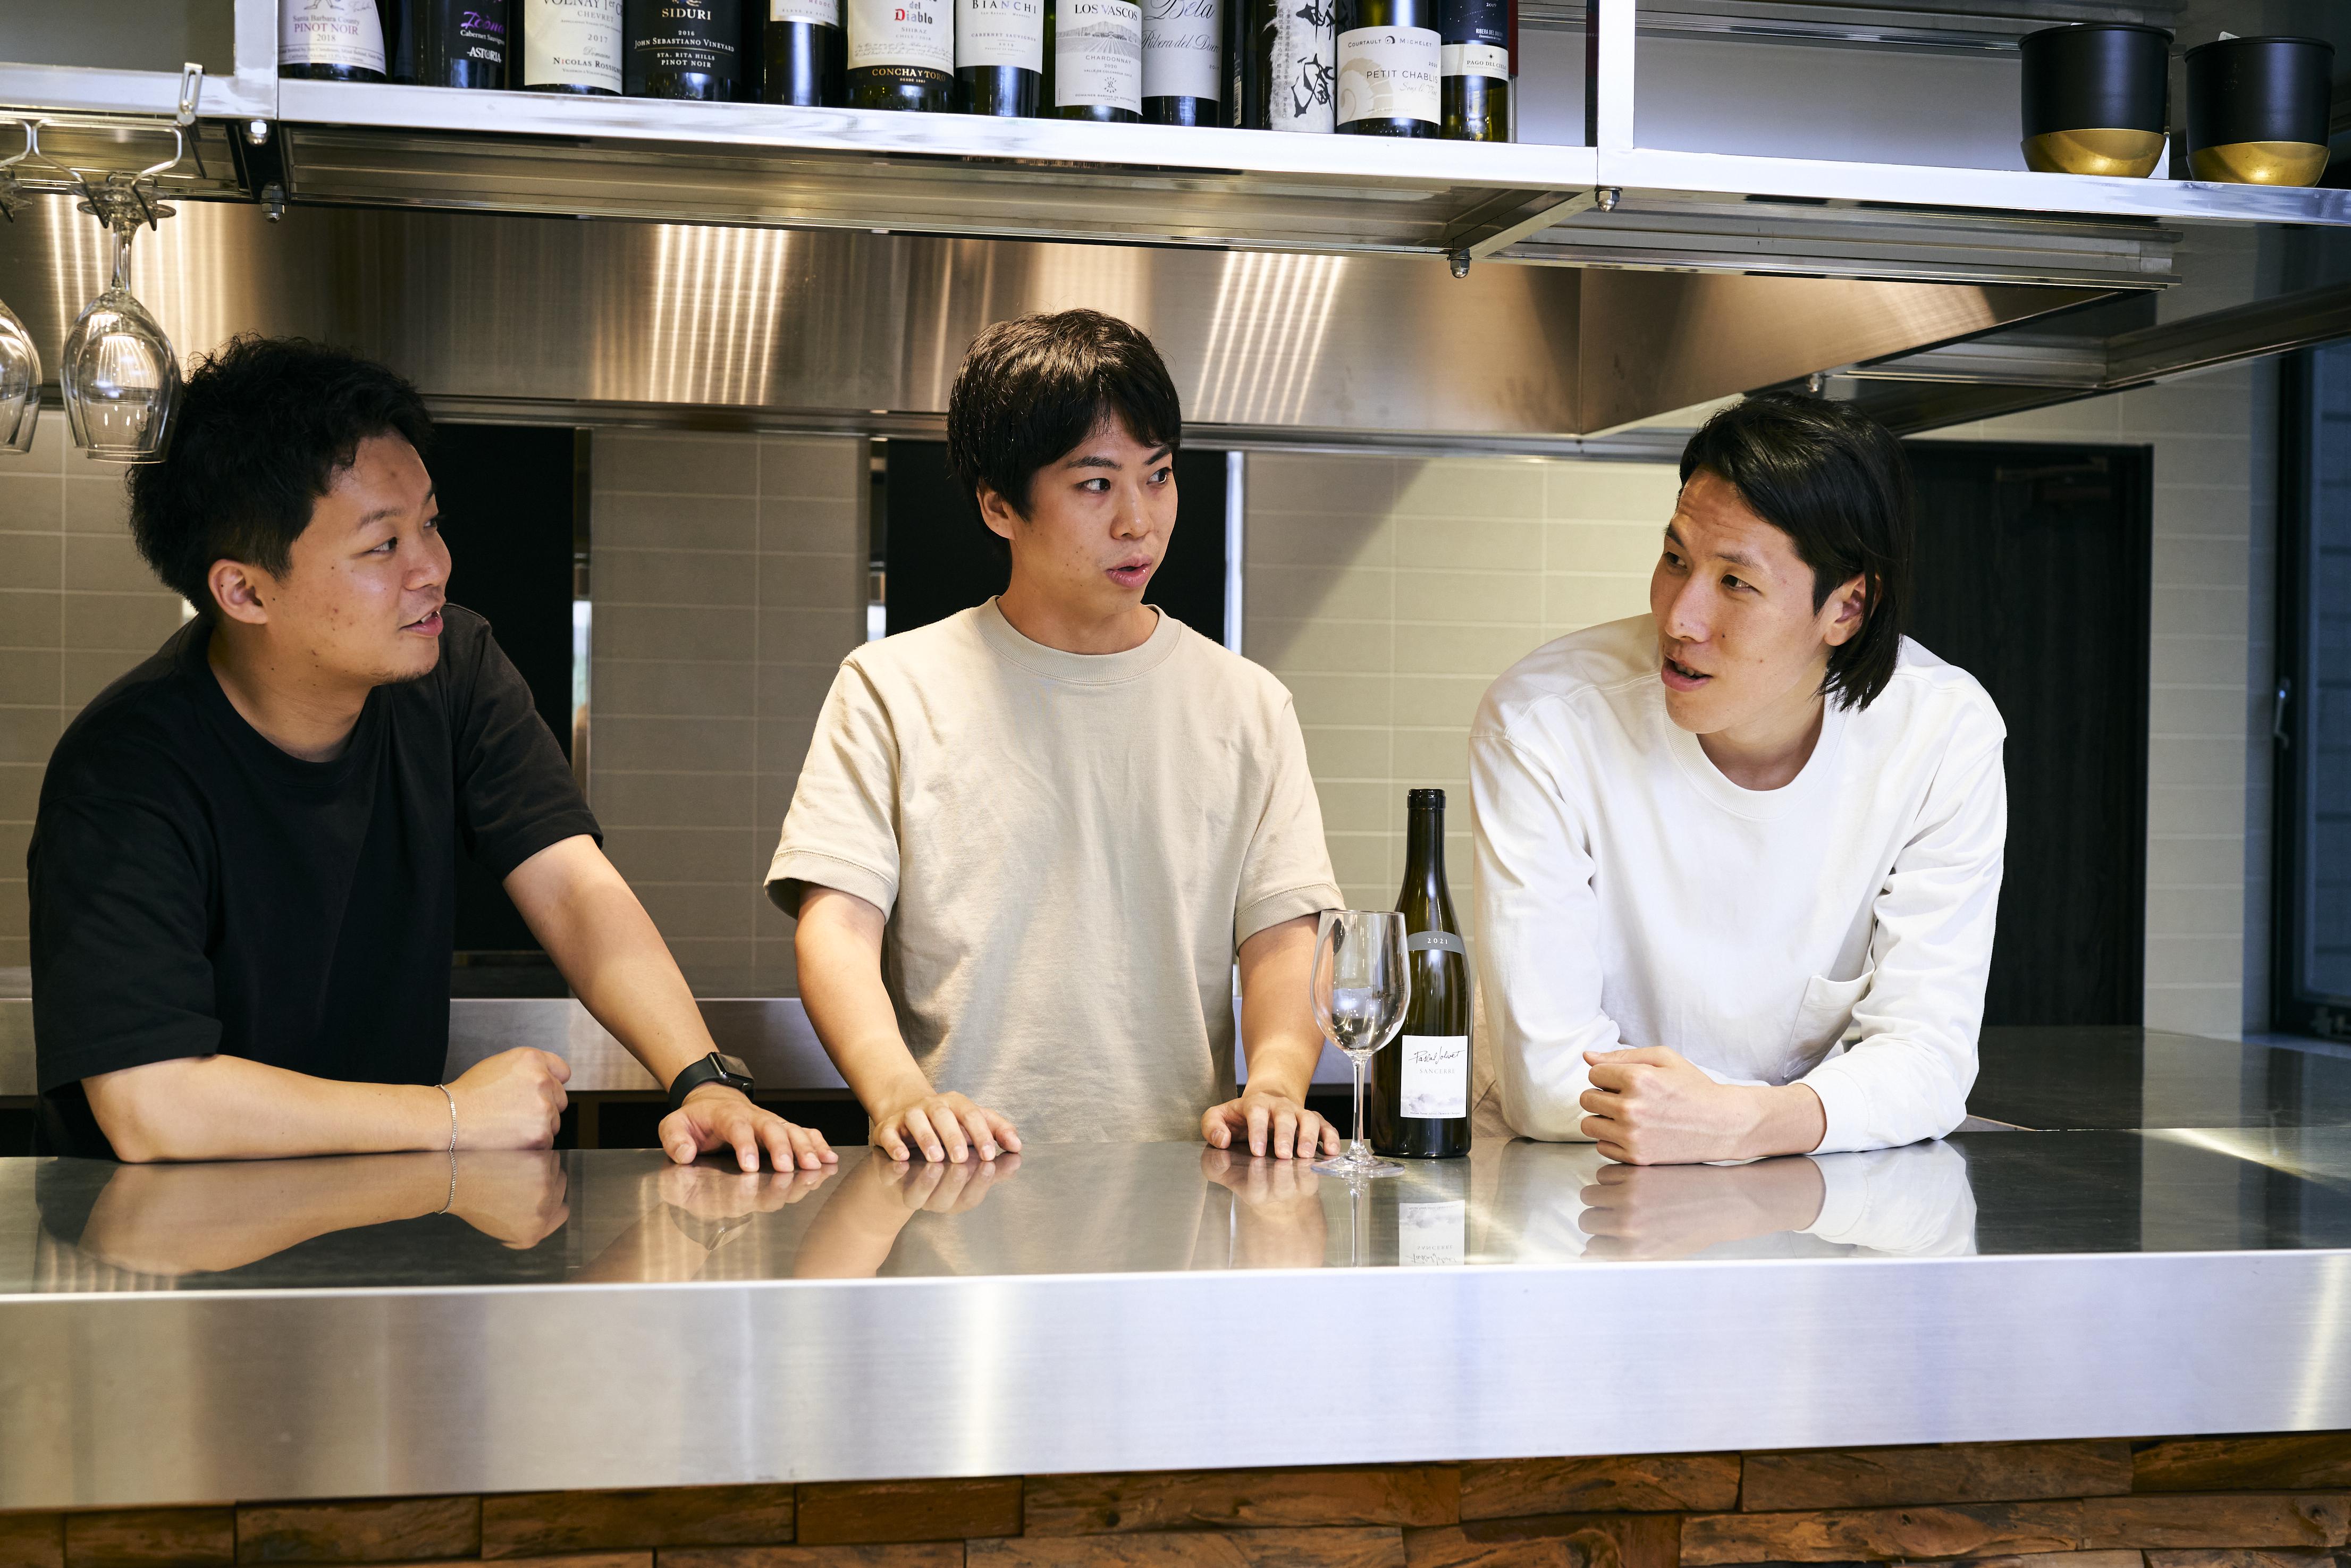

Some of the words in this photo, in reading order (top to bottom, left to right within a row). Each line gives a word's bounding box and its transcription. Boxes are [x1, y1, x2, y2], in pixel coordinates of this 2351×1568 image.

[909, 1, 921, 10] del
[973, 0, 1036, 14] BIANCHI
[662, 8, 712, 20] SIDURI
[894, 8, 933, 24] Diablo
[1074, 4, 1098, 14] LOS
[1101, 4, 1137, 21] VASCOS
[338, 16, 360, 26] County
[294, 23, 327, 33] PINOT
[331, 25, 358, 35] NOIR
[588, 33, 609, 43] 2017
[1142, 29, 1174, 50] Ribera
[1174, 33, 1194, 49] del
[1348, 39, 1381, 48] COURTAULT
[1400, 38, 1431, 47] MICHELET
[635, 40, 650, 49] JOHN
[652, 37, 701, 46] SEBASTIANO
[703, 39, 735, 52] VINEYARD
[467, 46, 502, 63] ASTORIA
[1085, 55, 1132, 64] CHARDONNAY
[553, 57, 592, 67] NICOLAS
[872, 68, 916, 77] CONCHA
[924, 71, 946, 82] TORO
[1367, 70, 1397, 79] PETIT
[1402, 70, 1438, 83] CHABLIS
